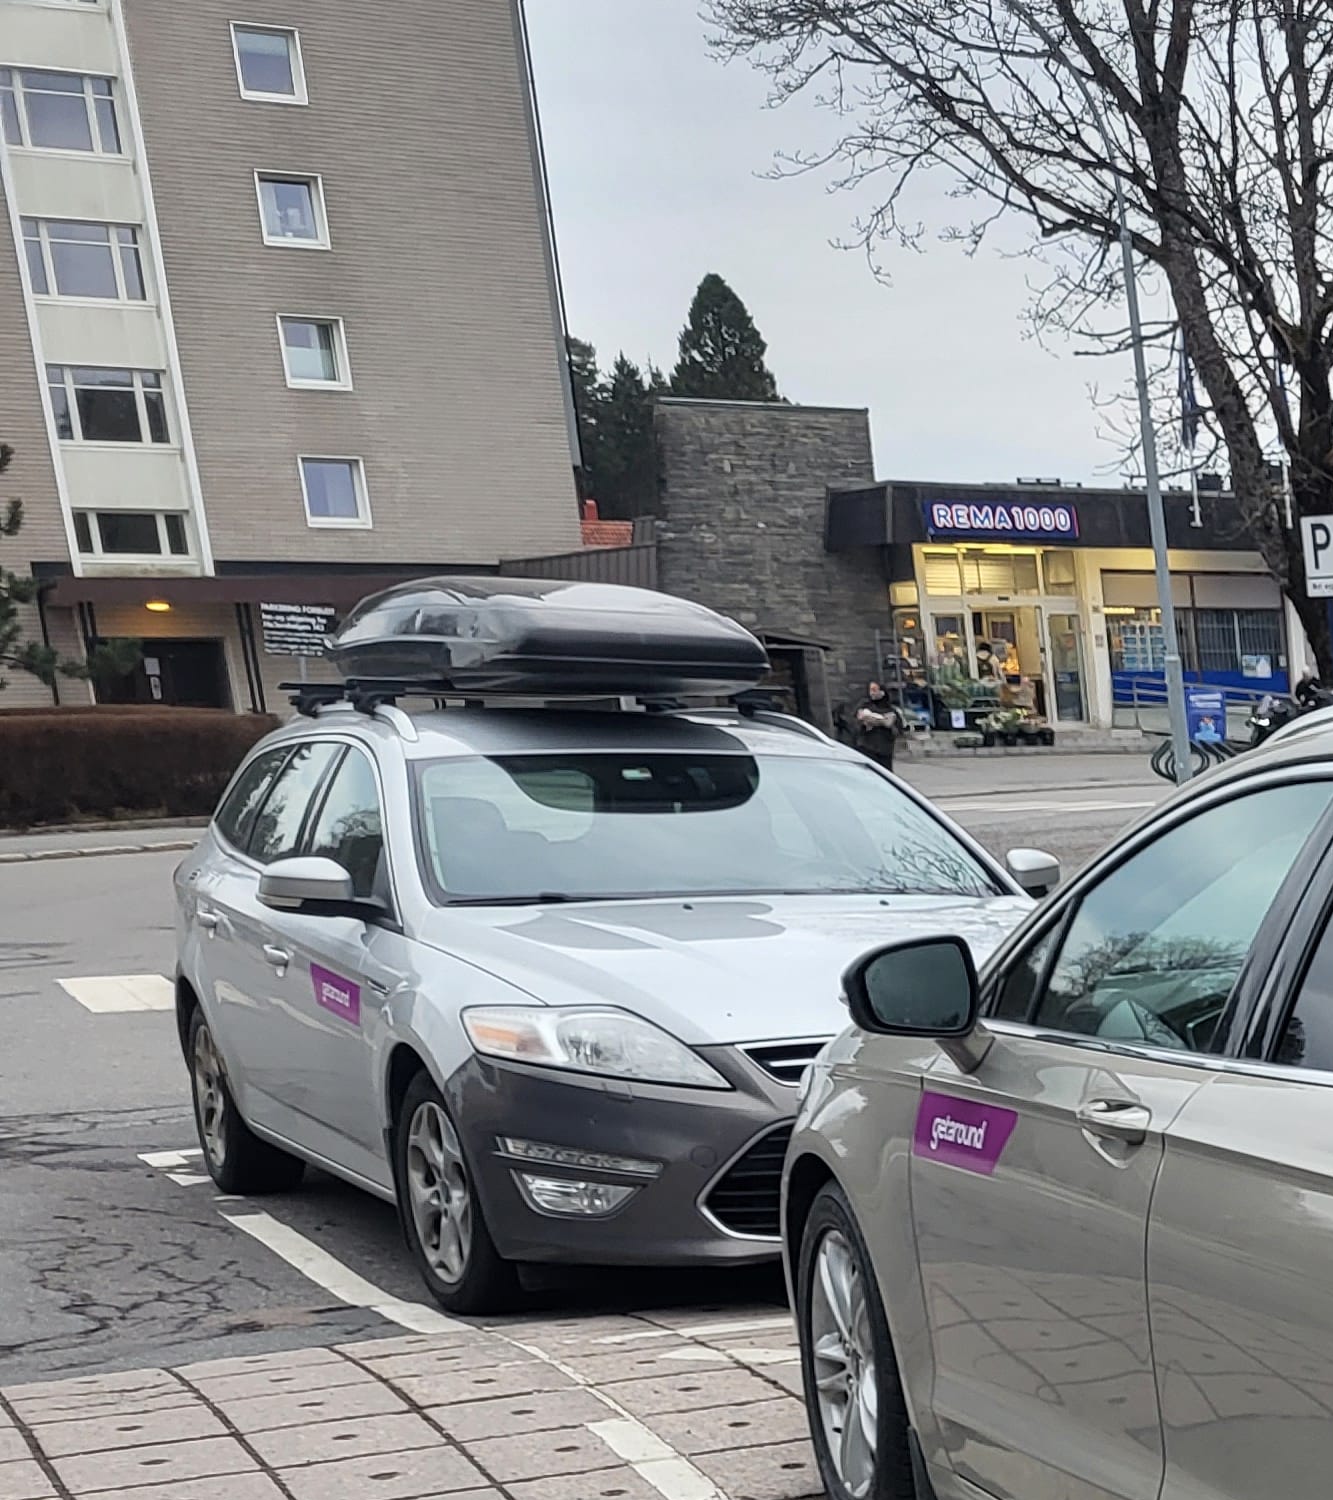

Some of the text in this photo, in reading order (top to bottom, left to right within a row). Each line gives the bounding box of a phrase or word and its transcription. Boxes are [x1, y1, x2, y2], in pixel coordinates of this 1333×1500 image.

[932, 504, 1071, 532] REMA 1000
[1310, 523, 1331, 570] P
